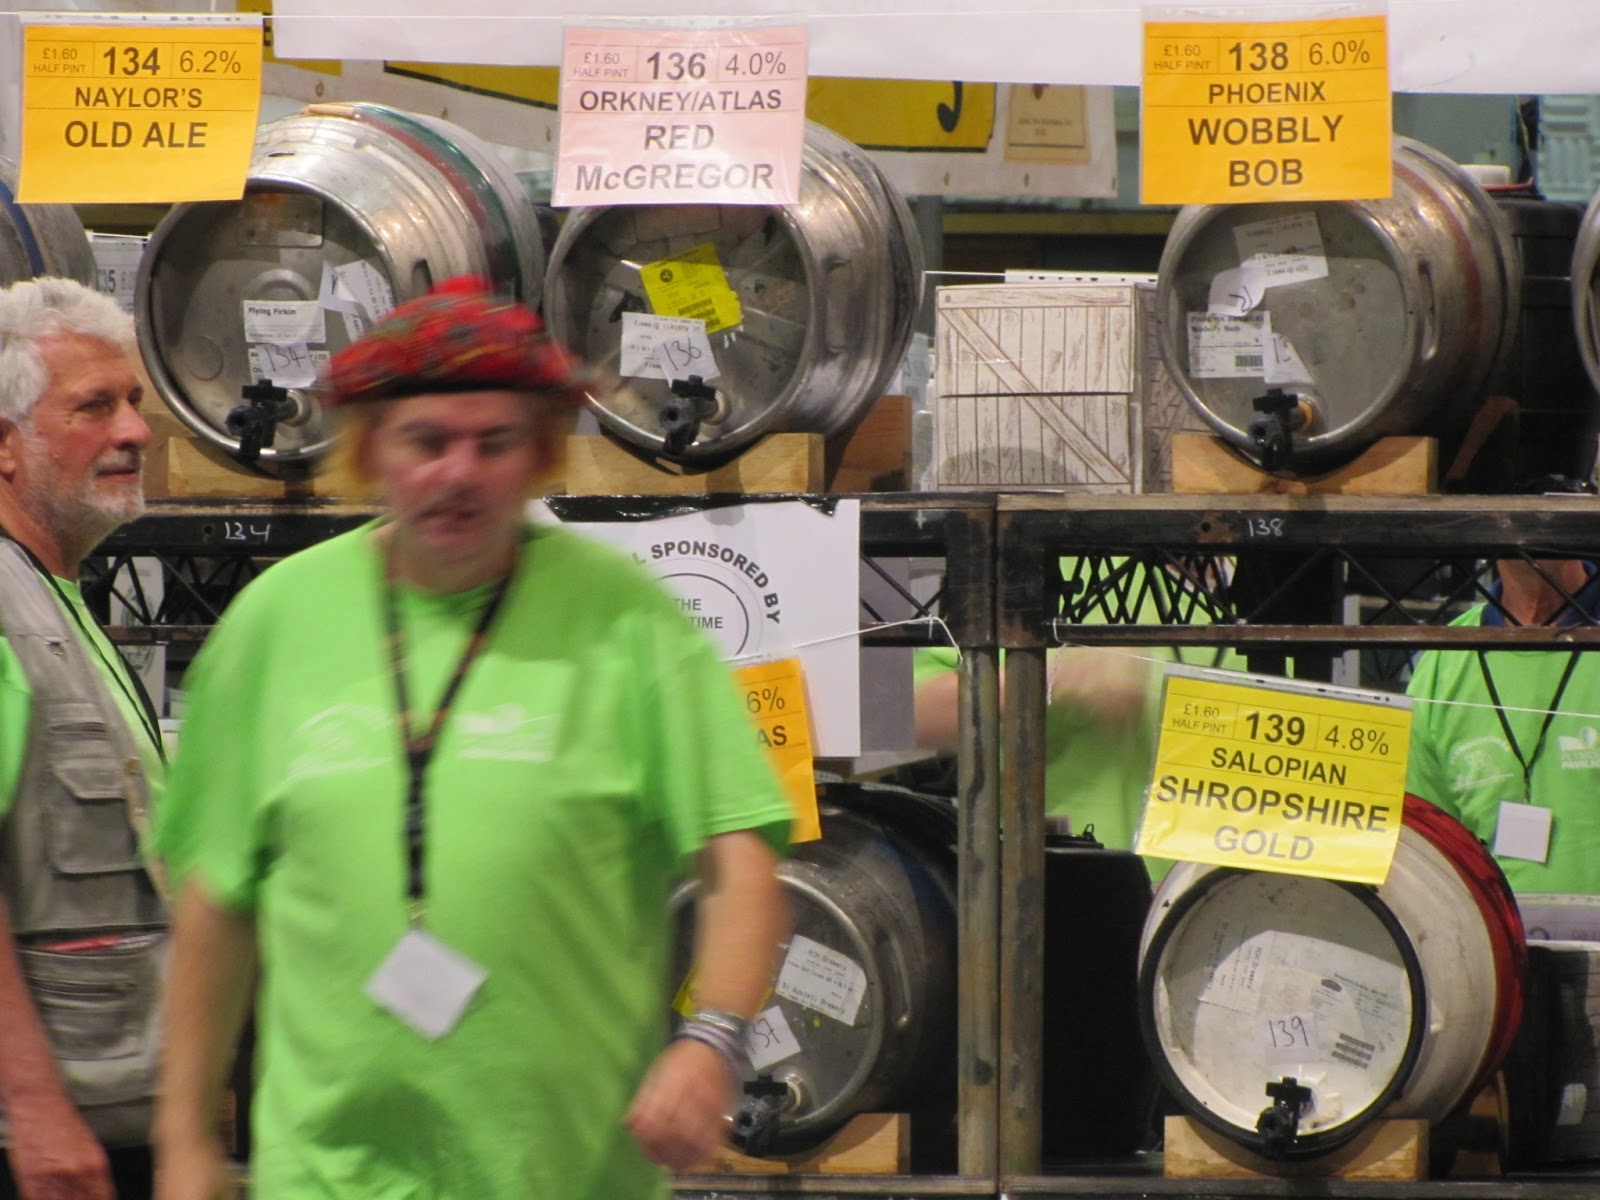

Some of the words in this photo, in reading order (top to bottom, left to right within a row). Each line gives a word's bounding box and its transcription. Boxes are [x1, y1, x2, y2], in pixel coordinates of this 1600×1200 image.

[43, 48, 78, 60] £1.60
[104, 47, 160, 76] 134
[180, 50, 241, 74] 6.2%
[584, 52, 620, 65] £1.60
[725, 51, 786, 76] 4.0%
[1164, 44, 1200, 57] £1.60
[1229, 42, 1288, 71] 138
[1308, 40, 1370, 66] 6.0%
[33, 64, 60, 73] HALF
[63, 64, 86, 73] PINT
[574, 68, 600, 78] HALF
[604, 69, 628, 78] PINT
[647, 51, 706, 81] 136
[1154, 60, 1183, 70] HALF
[1186, 60, 1210, 70] PINT
[75, 87, 202, 109] NAYLOR'S
[580, 89, 782, 112] ORKNEY/ATLAS
[1209, 81, 1326, 104] PHOENIX
[64, 120, 132, 148] OLD
[142, 122, 208, 148] ALE
[644, 124, 714, 150] RED
[1188, 114, 1344, 146] WOBBLY
[576, 163, 774, 191] McGREGOR
[1229, 158, 1304, 187] BOB
[248, 306, 272, 316] Flying
[264, 344, 306, 372] 134
[663, 336, 702, 371] 136
[224, 521, 271, 544] 134
[1248, 517, 1284, 537] 138
[650, 540, 769, 588] SPONSORED
[764, 592, 780, 625] BY
[672, 598, 702, 610] THE
[1184, 703, 1220, 718] £1.60
[1172, 718, 1200, 730] HALF
[1202, 721, 1228, 734] PINT
[1246, 711, 1305, 746] 139
[1324, 725, 1390, 756] 4.8%
[1211, 747, 1347, 786] SALOPIAN
[1156, 775, 1390, 834] SHROPSHIRE
[1214, 825, 1315, 861] GOLD
[1268, 1016, 1310, 1048] 139
